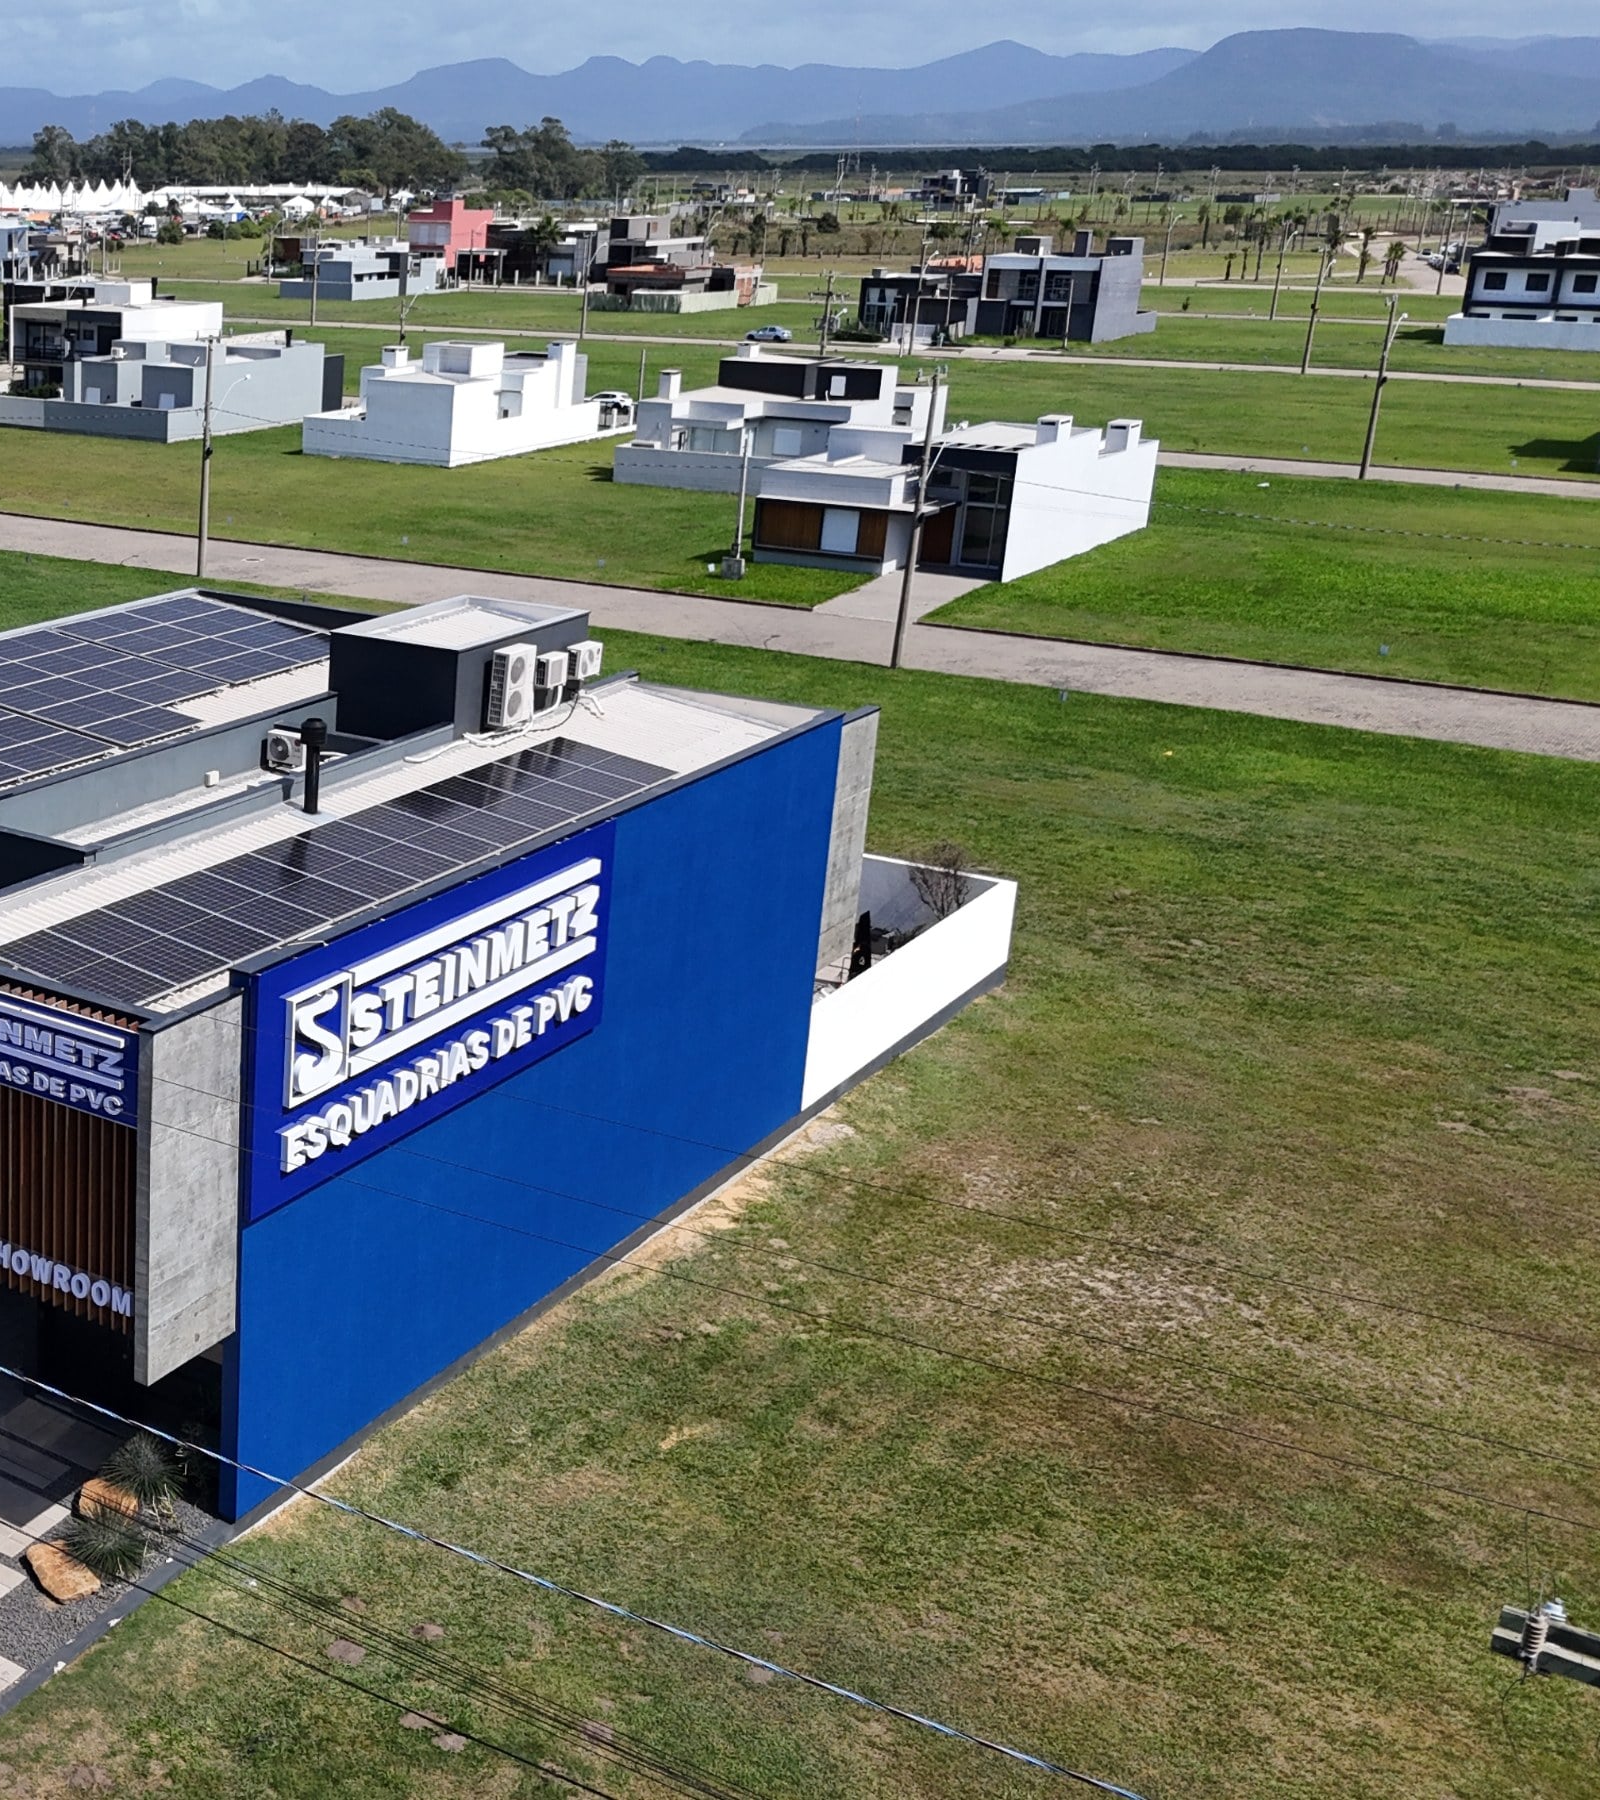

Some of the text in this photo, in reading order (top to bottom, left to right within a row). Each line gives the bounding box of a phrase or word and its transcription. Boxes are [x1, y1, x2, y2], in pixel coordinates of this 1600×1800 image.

[349, 883, 600, 1047] STEINMETZ
[33, 1070, 66, 1098] DE
[70, 1083, 125, 1116] PVC
[275, 974, 594, 1173] ESQUADRIAS DE PVC
